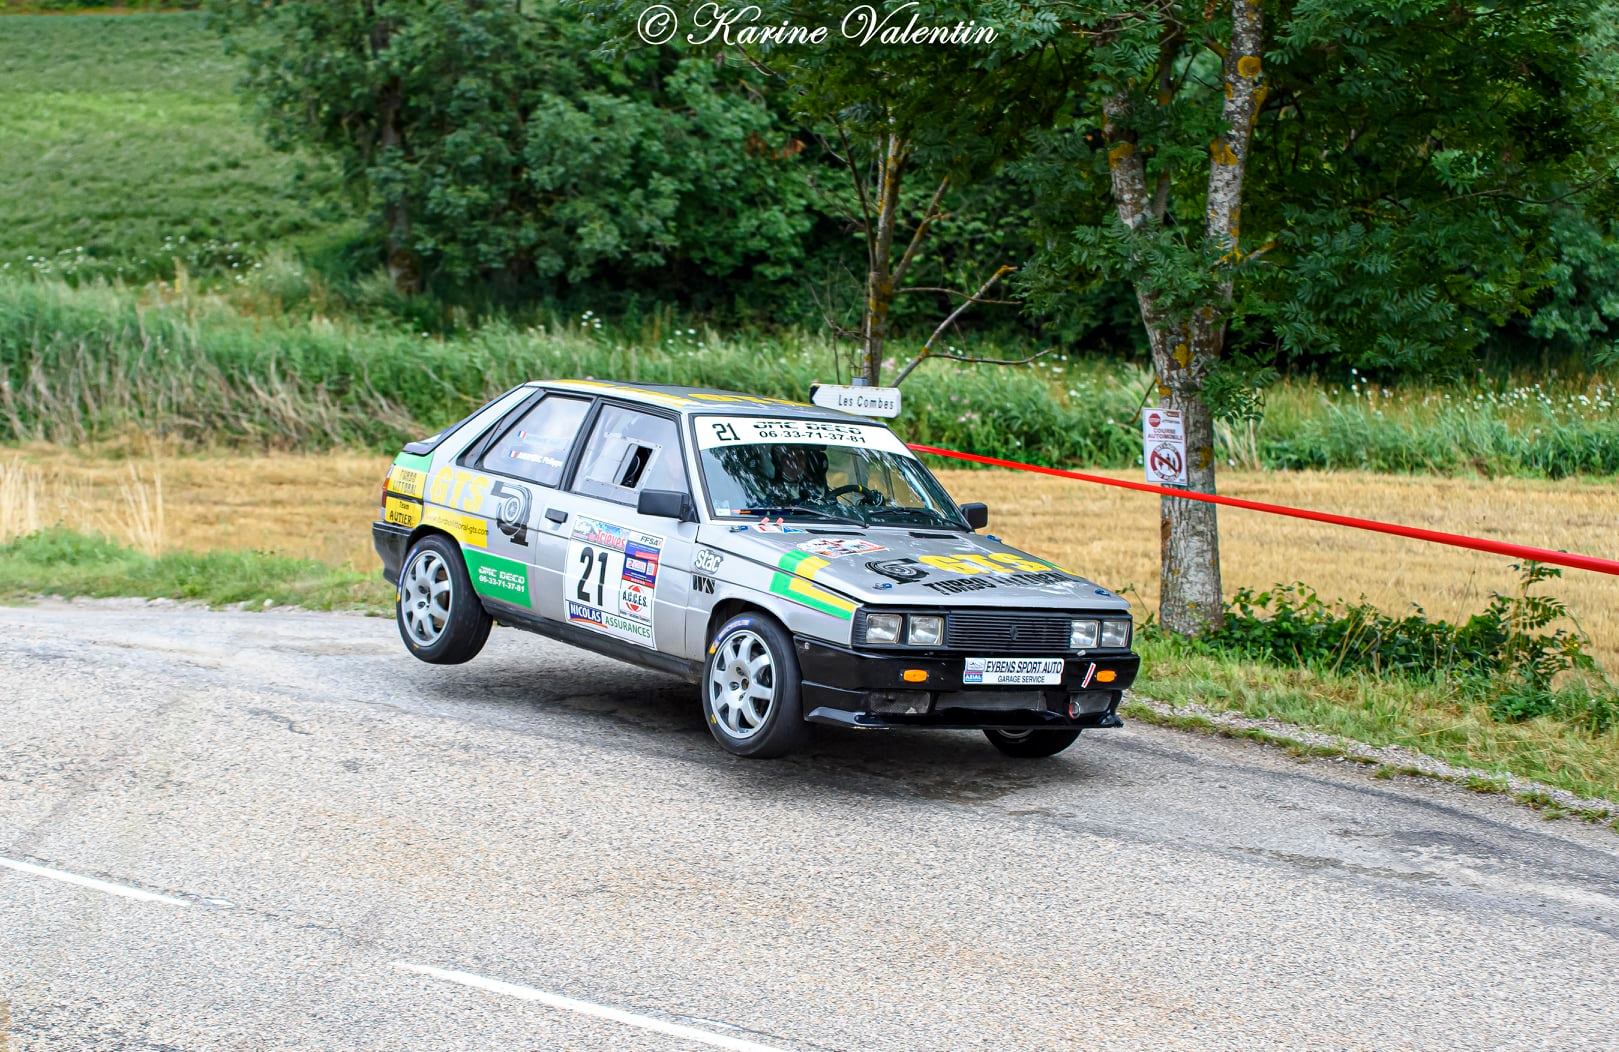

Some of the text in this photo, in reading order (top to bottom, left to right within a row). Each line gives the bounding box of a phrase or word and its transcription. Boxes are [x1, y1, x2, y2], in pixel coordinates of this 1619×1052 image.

[838, 394, 894, 410] Les Combes
[712, 422, 741, 442] 21
[753, 421, 862, 435] JMC DECO
[429, 466, 489, 513] GTS
[389, 510, 412, 526] AUTIER
[640, 535, 659, 547] FFSA
[695, 549, 722, 572] stac
[917, 552, 1053, 575] GTS
[499, 571, 525, 585] DECO
[577, 546, 608, 607] 21
[922, 575, 998, 596] TURBO
[570, 602, 602, 622] NICOLAS
[605, 616, 651, 639] ASSURANCES
[985, 660, 1063, 674] EYBENS SPORT AUTO
[998, 675, 1046, 684] GARAGE SERVICE
